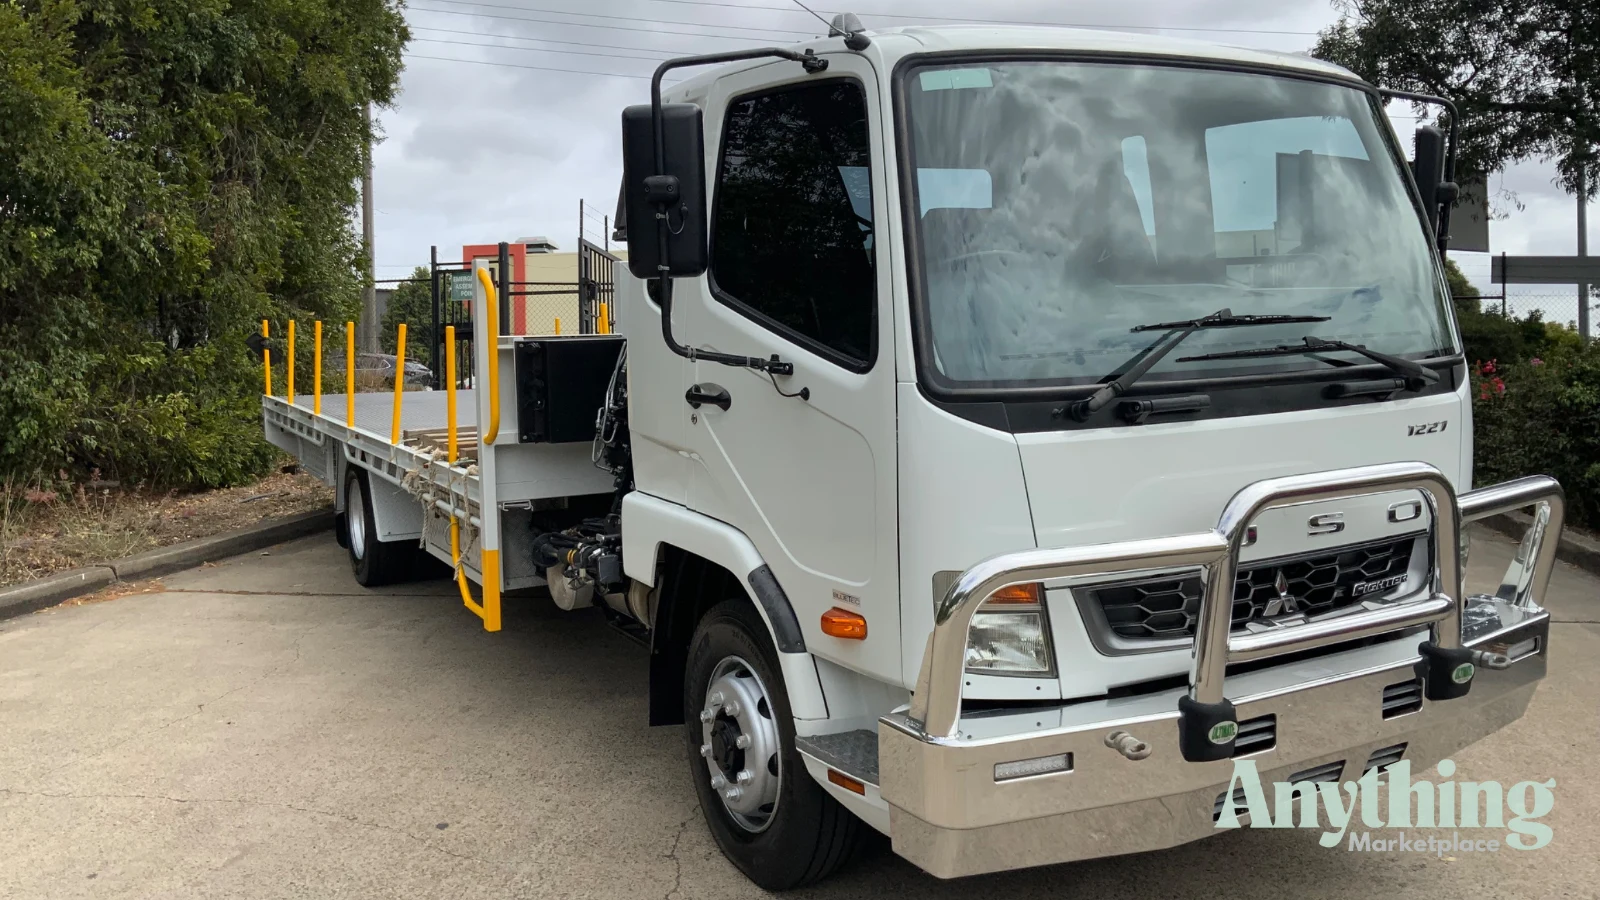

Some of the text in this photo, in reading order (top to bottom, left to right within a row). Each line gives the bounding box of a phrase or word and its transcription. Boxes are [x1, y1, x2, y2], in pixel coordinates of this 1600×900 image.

[1407, 420, 1448, 437] 1227
[1352, 573, 1408, 597] FIGHTER
[832, 590, 861, 606] BLUETEC
